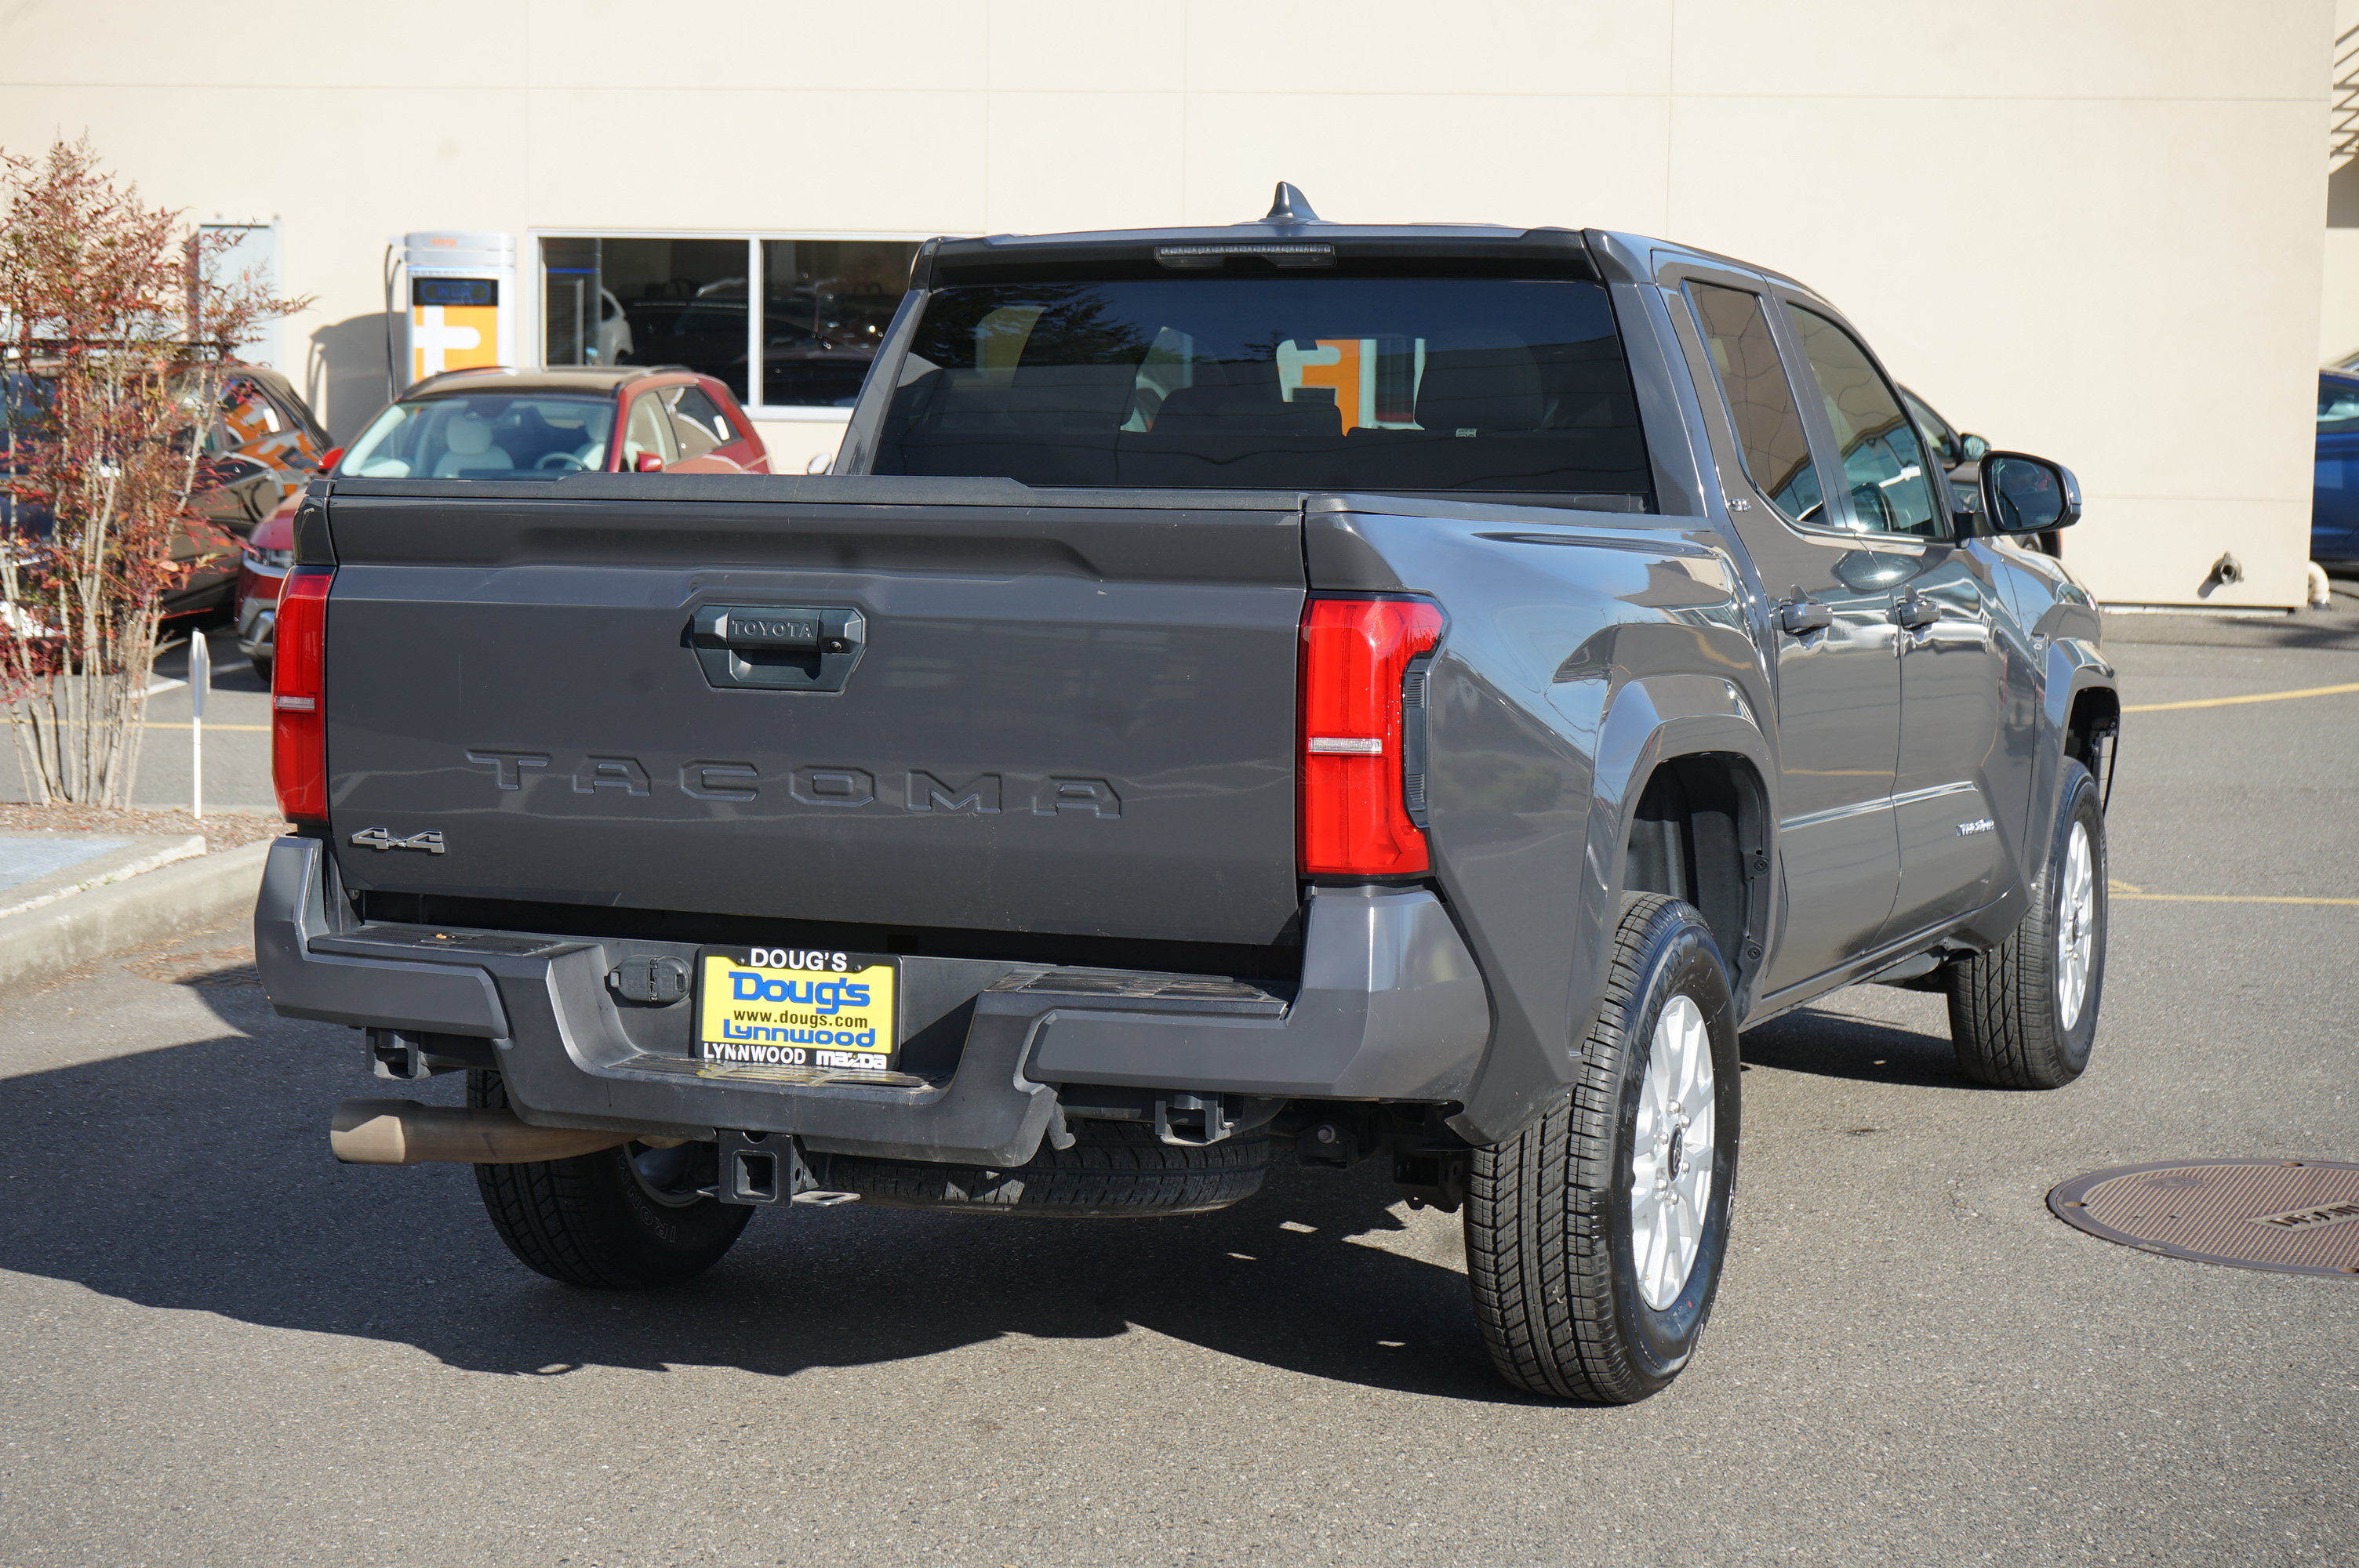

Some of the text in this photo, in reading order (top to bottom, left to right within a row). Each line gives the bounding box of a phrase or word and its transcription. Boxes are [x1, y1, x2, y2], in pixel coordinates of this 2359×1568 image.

[732, 619, 813, 638] TOYOTA
[465, 748, 1122, 819] TACOMA
[751, 948, 848, 971] DOUG'S
[729, 971, 871, 1014] Doug's
[733, 1010, 868, 1029] www.dougs.com
[723, 1019, 876, 1047] Lynnwood
[703, 1043, 806, 1065] LYNNWOOD
